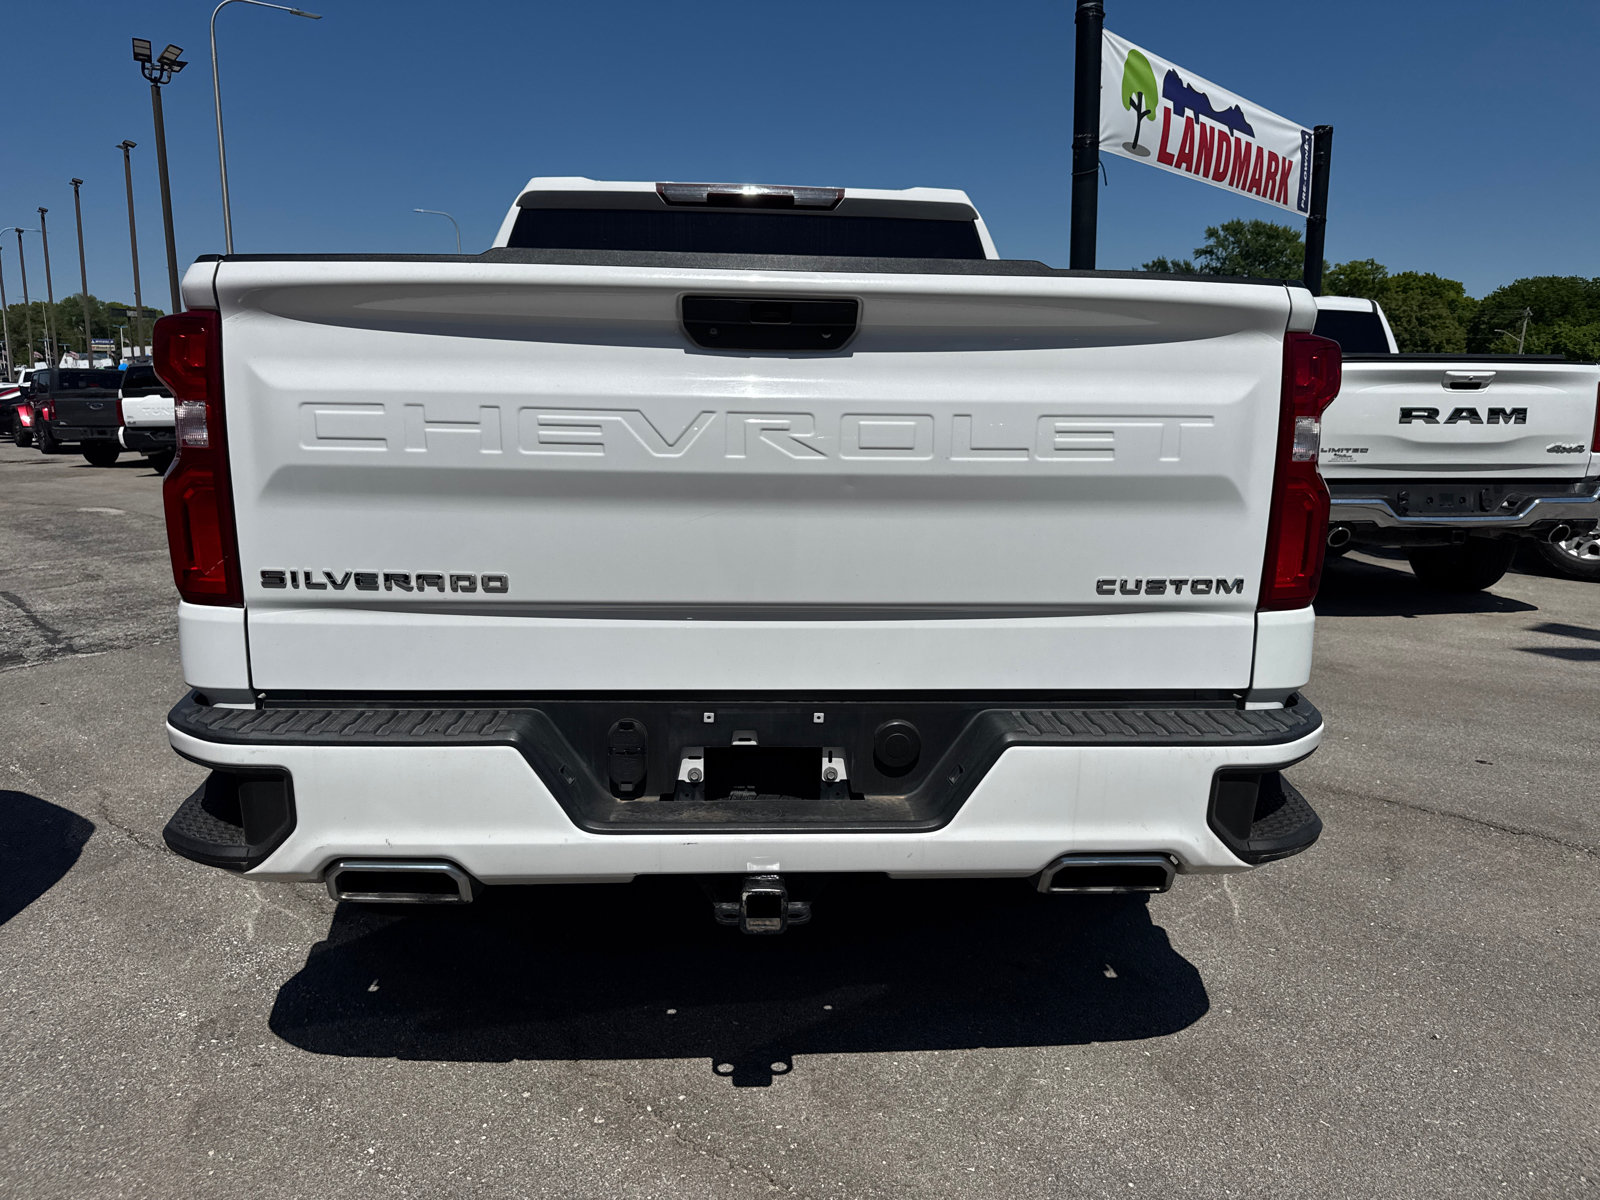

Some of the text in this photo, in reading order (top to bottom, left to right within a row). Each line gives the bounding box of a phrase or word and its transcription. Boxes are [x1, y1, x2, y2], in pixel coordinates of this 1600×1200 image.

[1157, 106, 1293, 206] LANDMARK
[1399, 407, 1528, 424] RAM
[299, 402, 1214, 461] CHEVROLET
[259, 568, 509, 593] SILVERADO
[1096, 577, 1244, 595] CUSTOM
